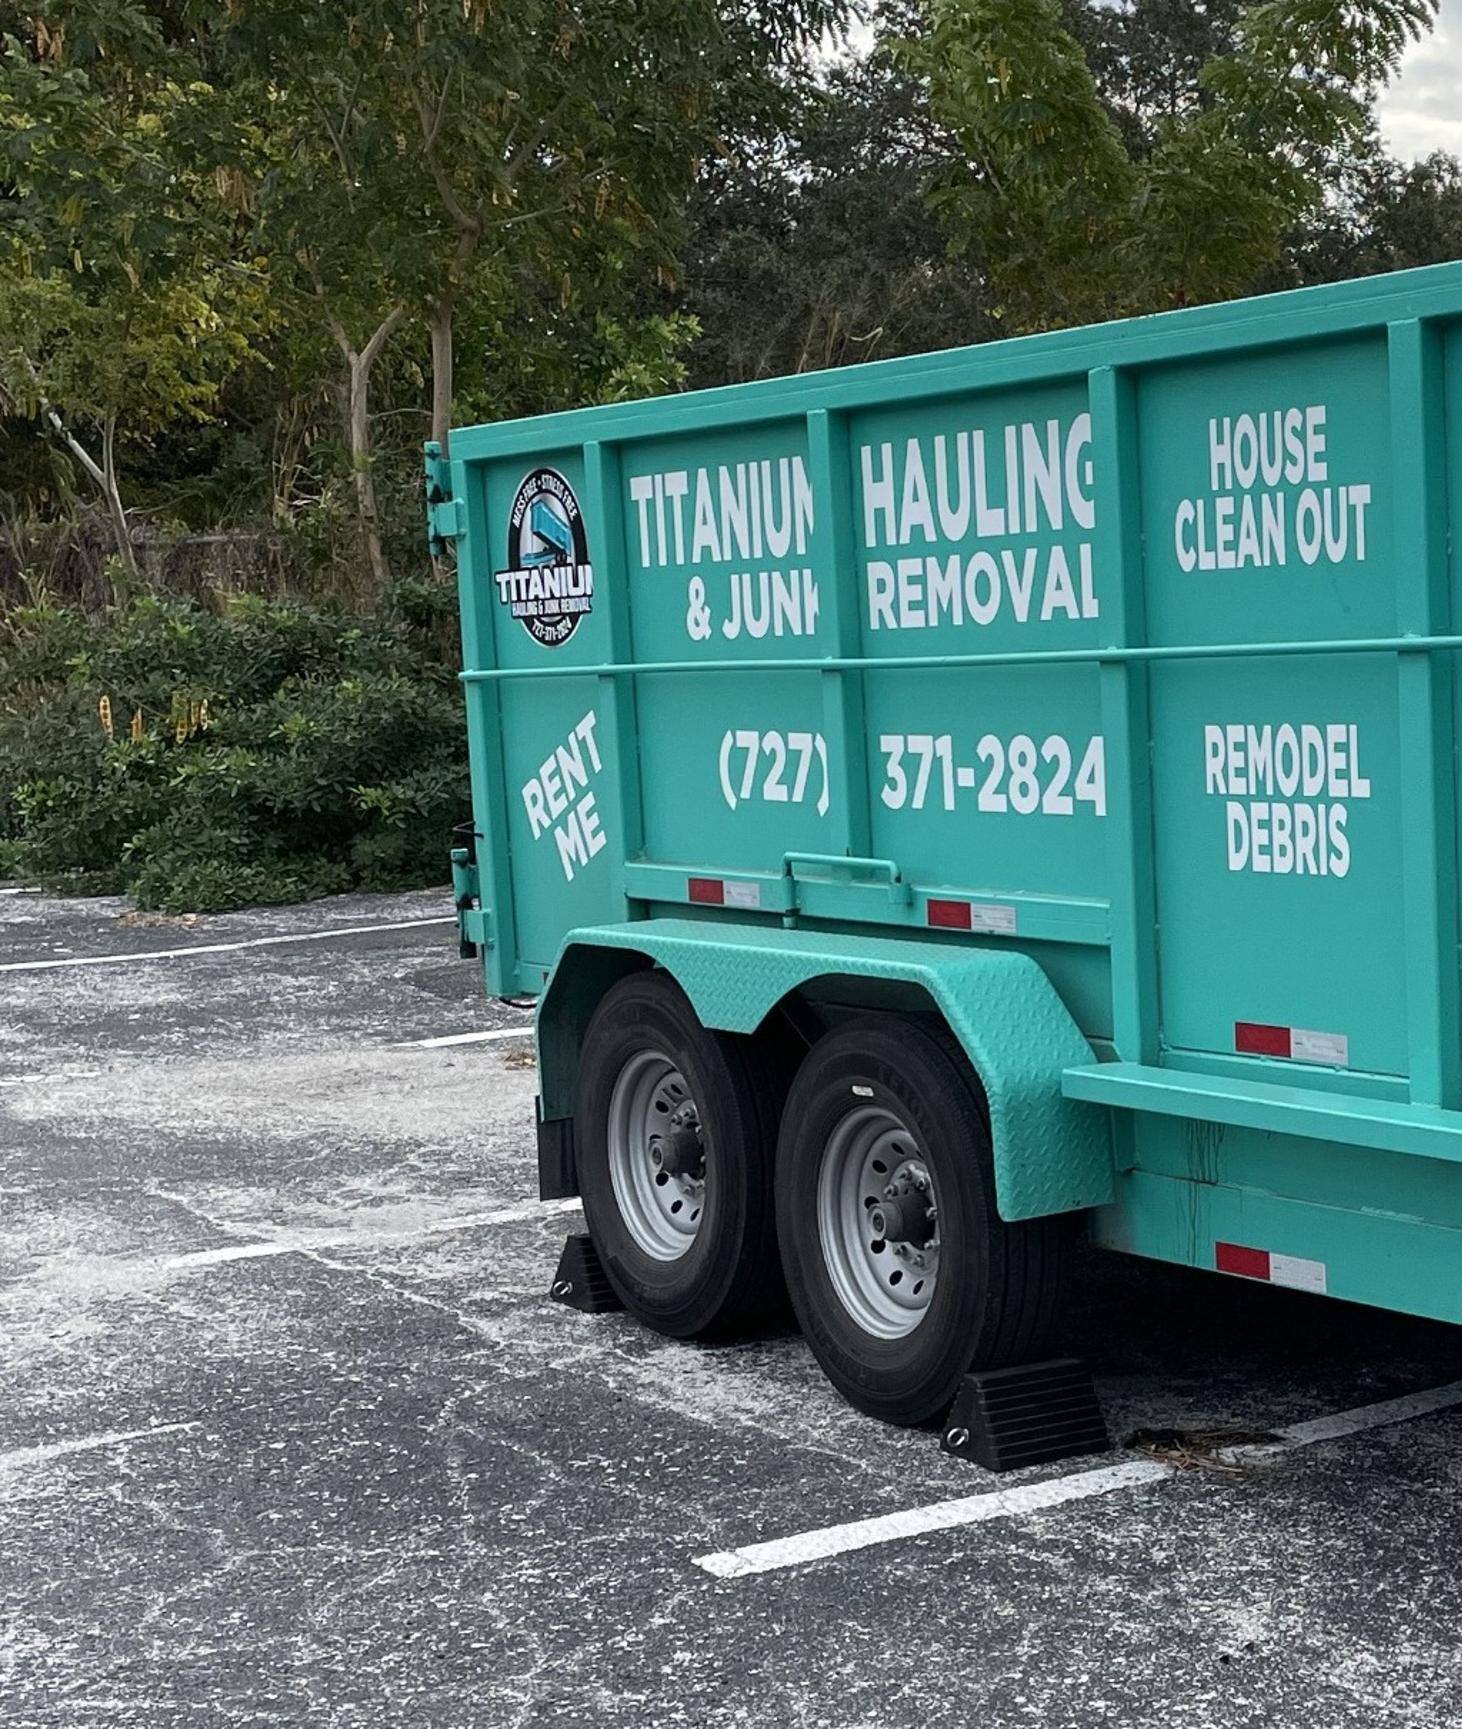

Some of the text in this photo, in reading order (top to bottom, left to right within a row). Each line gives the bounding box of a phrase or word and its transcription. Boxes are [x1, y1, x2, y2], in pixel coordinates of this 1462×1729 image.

[1208, 405, 1328, 490] HOUSE
[1174, 484, 1372, 572] CLEAN OUT
[686, 576, 712, 641] &
[867, 543, 1099, 631] REMOVAL
[521, 709, 602, 841] RENT
[719, 729, 1107, 817] (727) 371-2824
[1204, 723, 1371, 798] REMODEL
[554, 791, 607, 882] ME
[1226, 801, 1351, 877] DEBRIS
